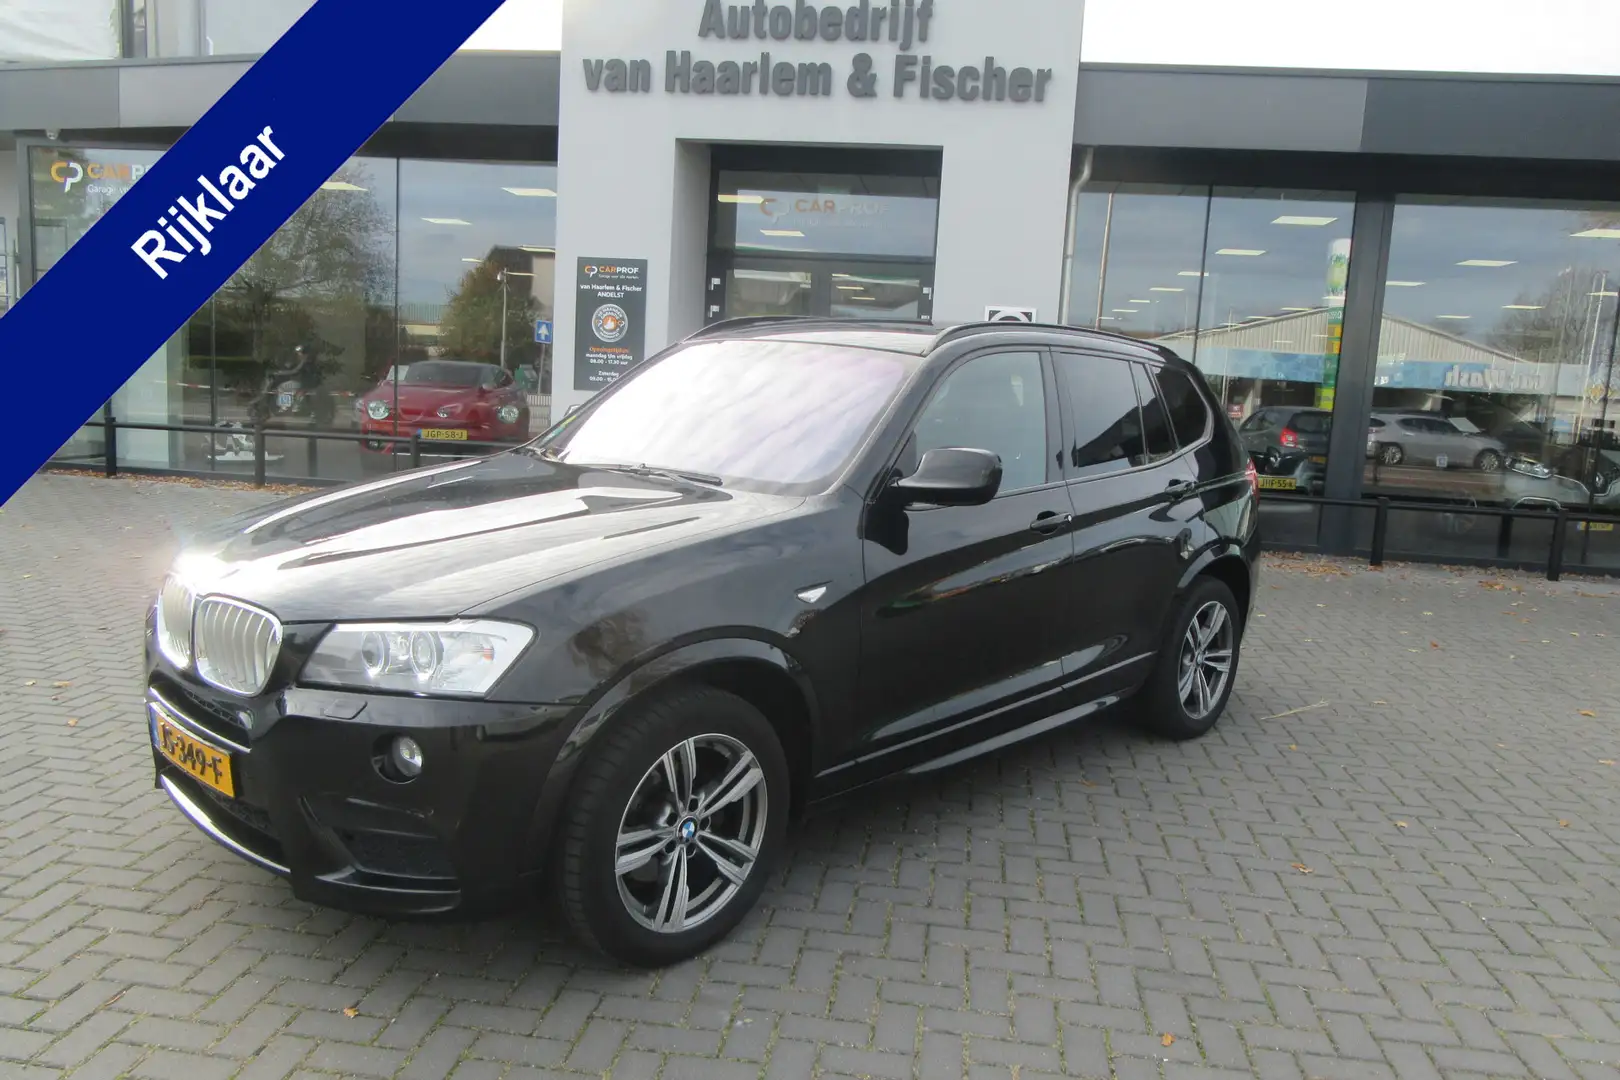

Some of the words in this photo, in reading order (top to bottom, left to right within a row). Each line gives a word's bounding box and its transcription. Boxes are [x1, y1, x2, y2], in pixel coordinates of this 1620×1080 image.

[698, 0, 934, 51] Autobedrijf
[583, 58, 651, 93] van
[665, 50, 832, 96] Haarlem
[847, 53, 877, 98] &
[893, 54, 1052, 102] Fischer
[599, 265, 639, 274] CARPROF
[425, 430, 464, 439] JGP-58-J
